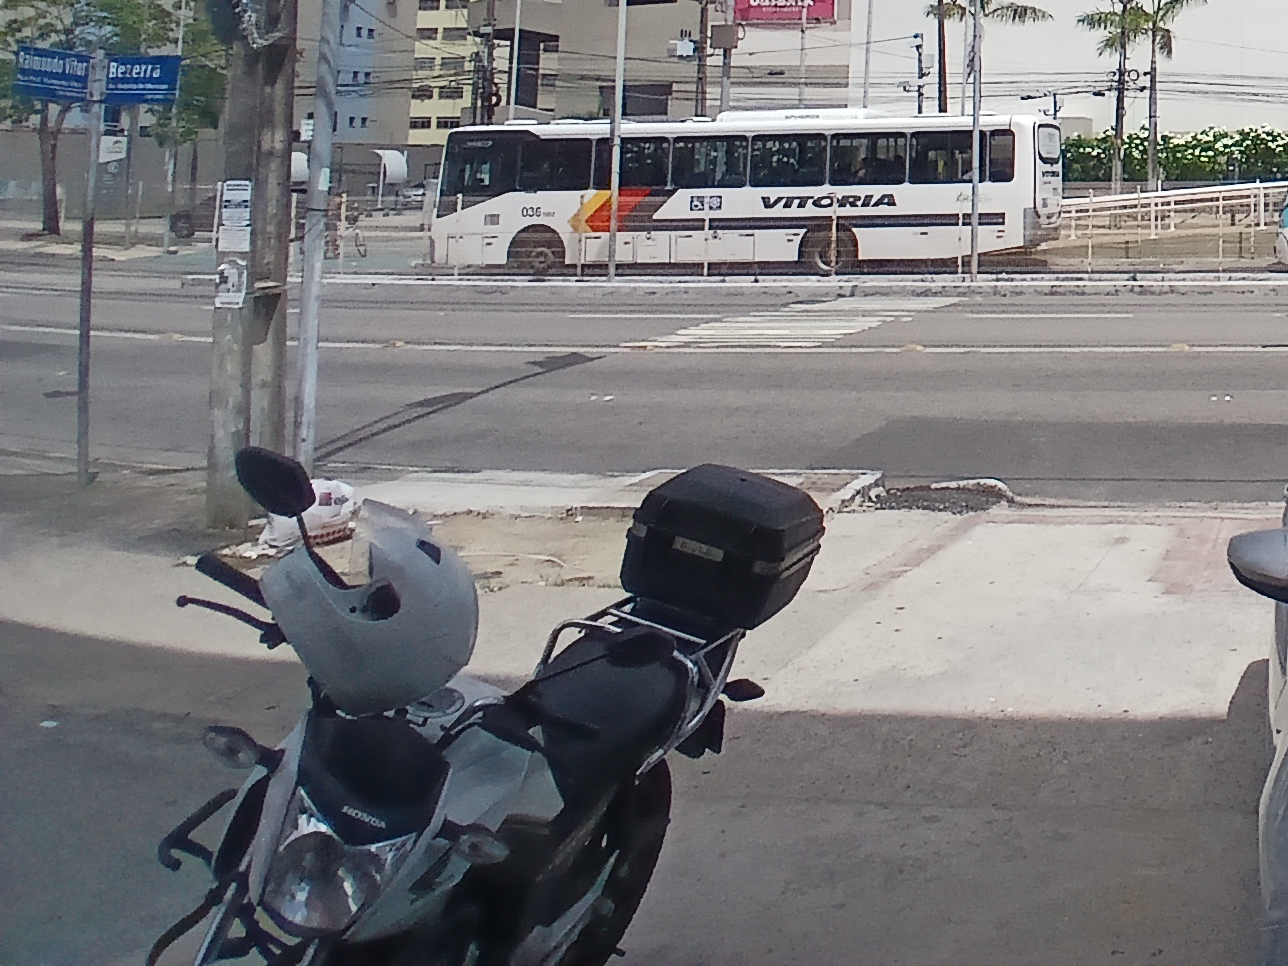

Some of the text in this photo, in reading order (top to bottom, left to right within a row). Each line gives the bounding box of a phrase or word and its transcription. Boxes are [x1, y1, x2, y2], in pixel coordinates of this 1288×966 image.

[18, 51, 64, 74] Raimundo
[108, 61, 161, 78] Bezerra
[760, 191, 898, 209] VITÓRIA
[521, 206, 542, 218] 036
[341, 805, 387, 829] HONDA
